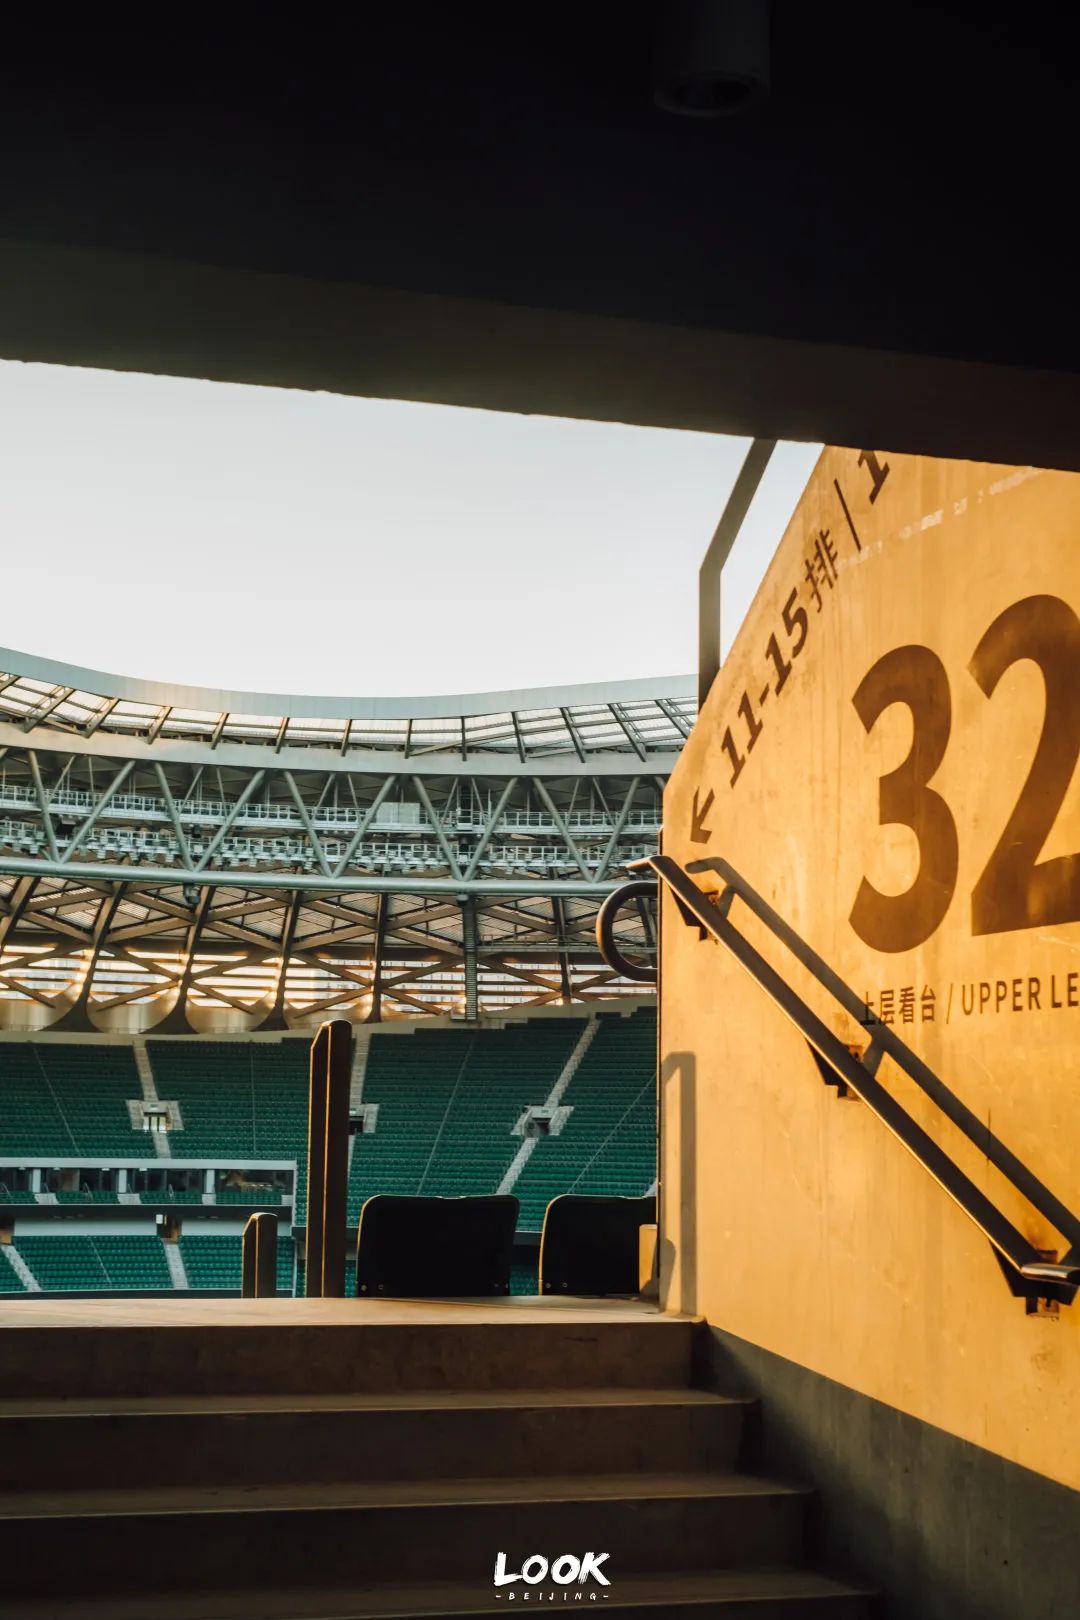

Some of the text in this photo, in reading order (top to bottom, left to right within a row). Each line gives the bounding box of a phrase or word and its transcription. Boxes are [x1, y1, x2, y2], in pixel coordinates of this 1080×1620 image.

[848, 594, 1080, 954] 32
[860, 984, 936, 1025] 上层看台
[961, 976, 1042, 1016] UPPER
[1051, 972, 1080, 1009] LE
